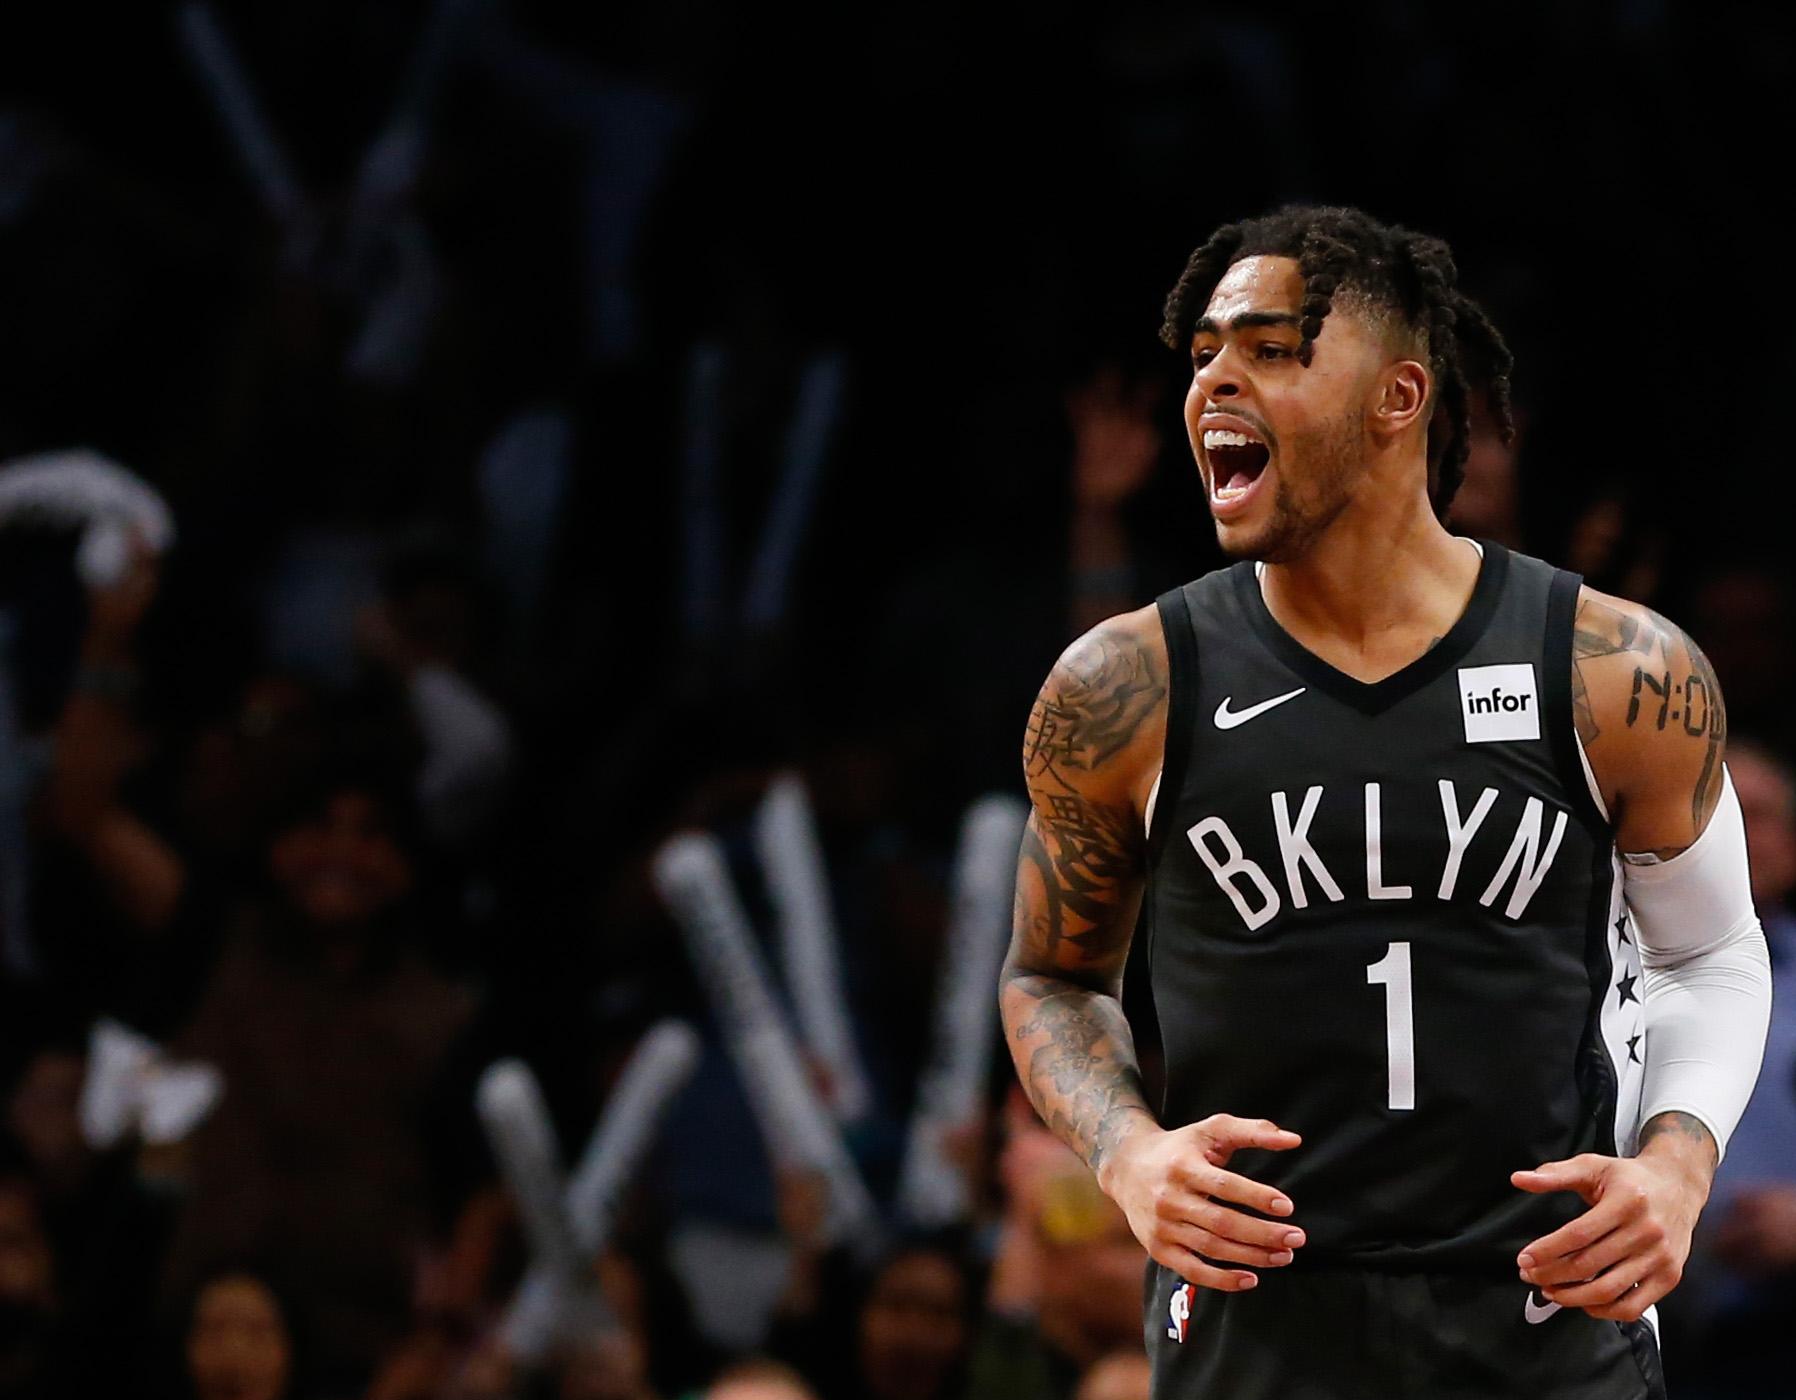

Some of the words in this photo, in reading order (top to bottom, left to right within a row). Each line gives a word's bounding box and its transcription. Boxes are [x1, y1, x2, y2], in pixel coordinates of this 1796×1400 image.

[1467, 688, 1531, 716] infor
[1186, 778, 1569, 932] BKLYN
[1365, 940, 1416, 1111] 1
